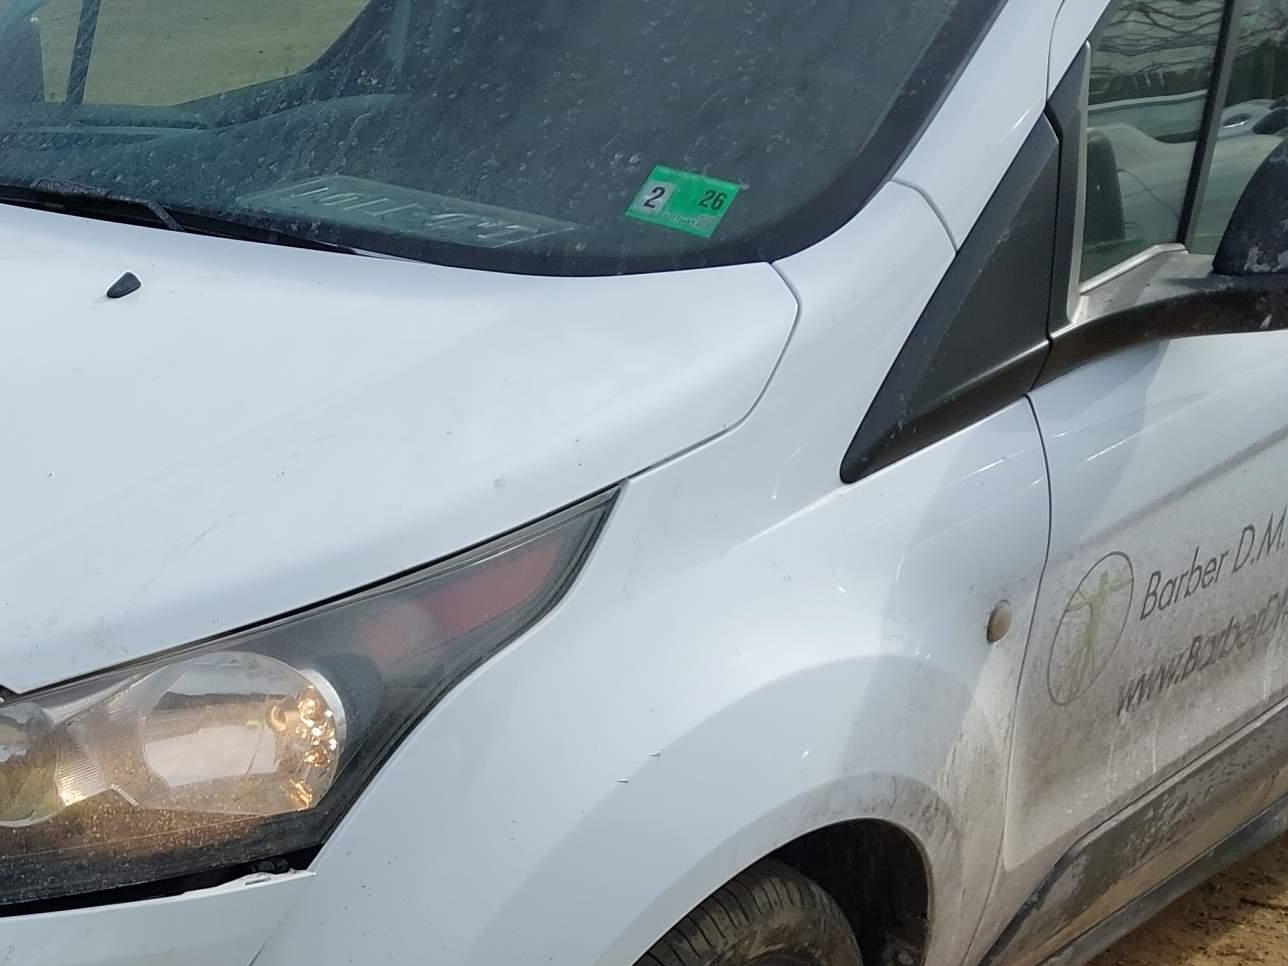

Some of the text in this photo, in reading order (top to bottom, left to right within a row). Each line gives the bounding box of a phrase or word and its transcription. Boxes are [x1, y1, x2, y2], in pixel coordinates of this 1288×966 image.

[643, 186, 728, 211] 2 26
[1139, 546, 1230, 622] Barber
